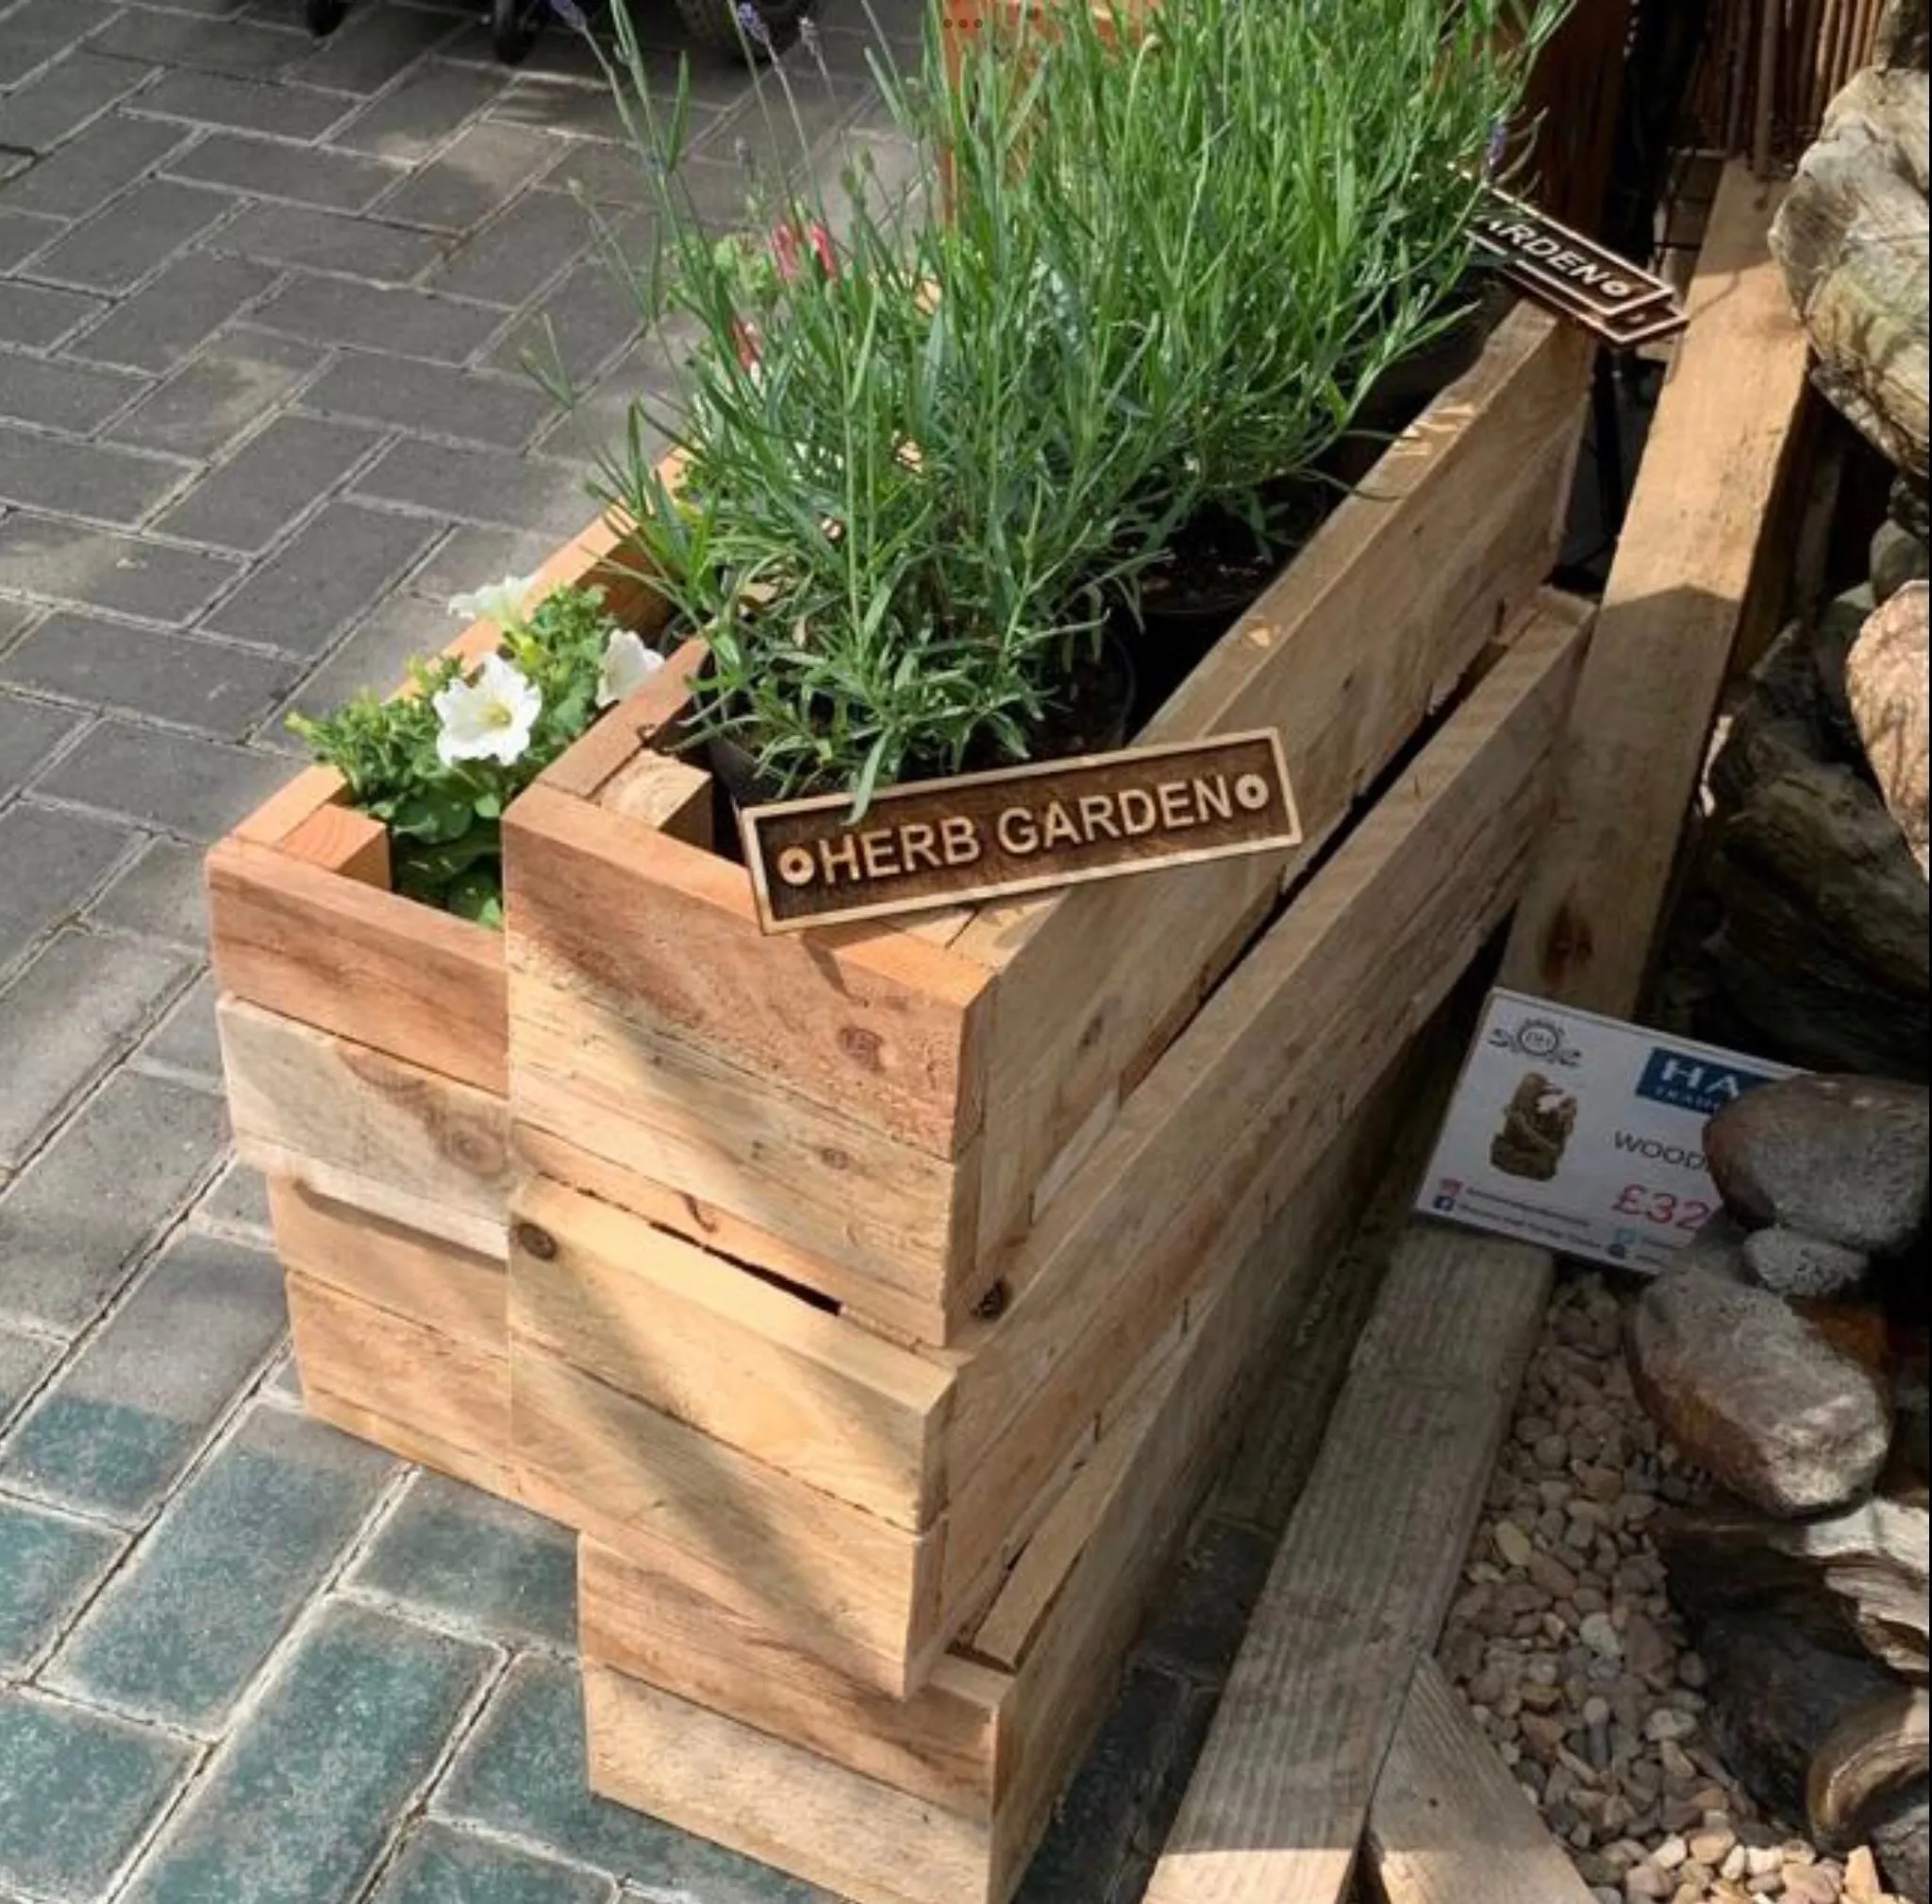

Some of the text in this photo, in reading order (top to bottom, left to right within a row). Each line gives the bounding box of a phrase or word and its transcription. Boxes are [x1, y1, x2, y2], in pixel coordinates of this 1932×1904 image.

[819, 774, 1232, 883] HERB GARDEN
[1611, 1183, 1710, 1230] £32
